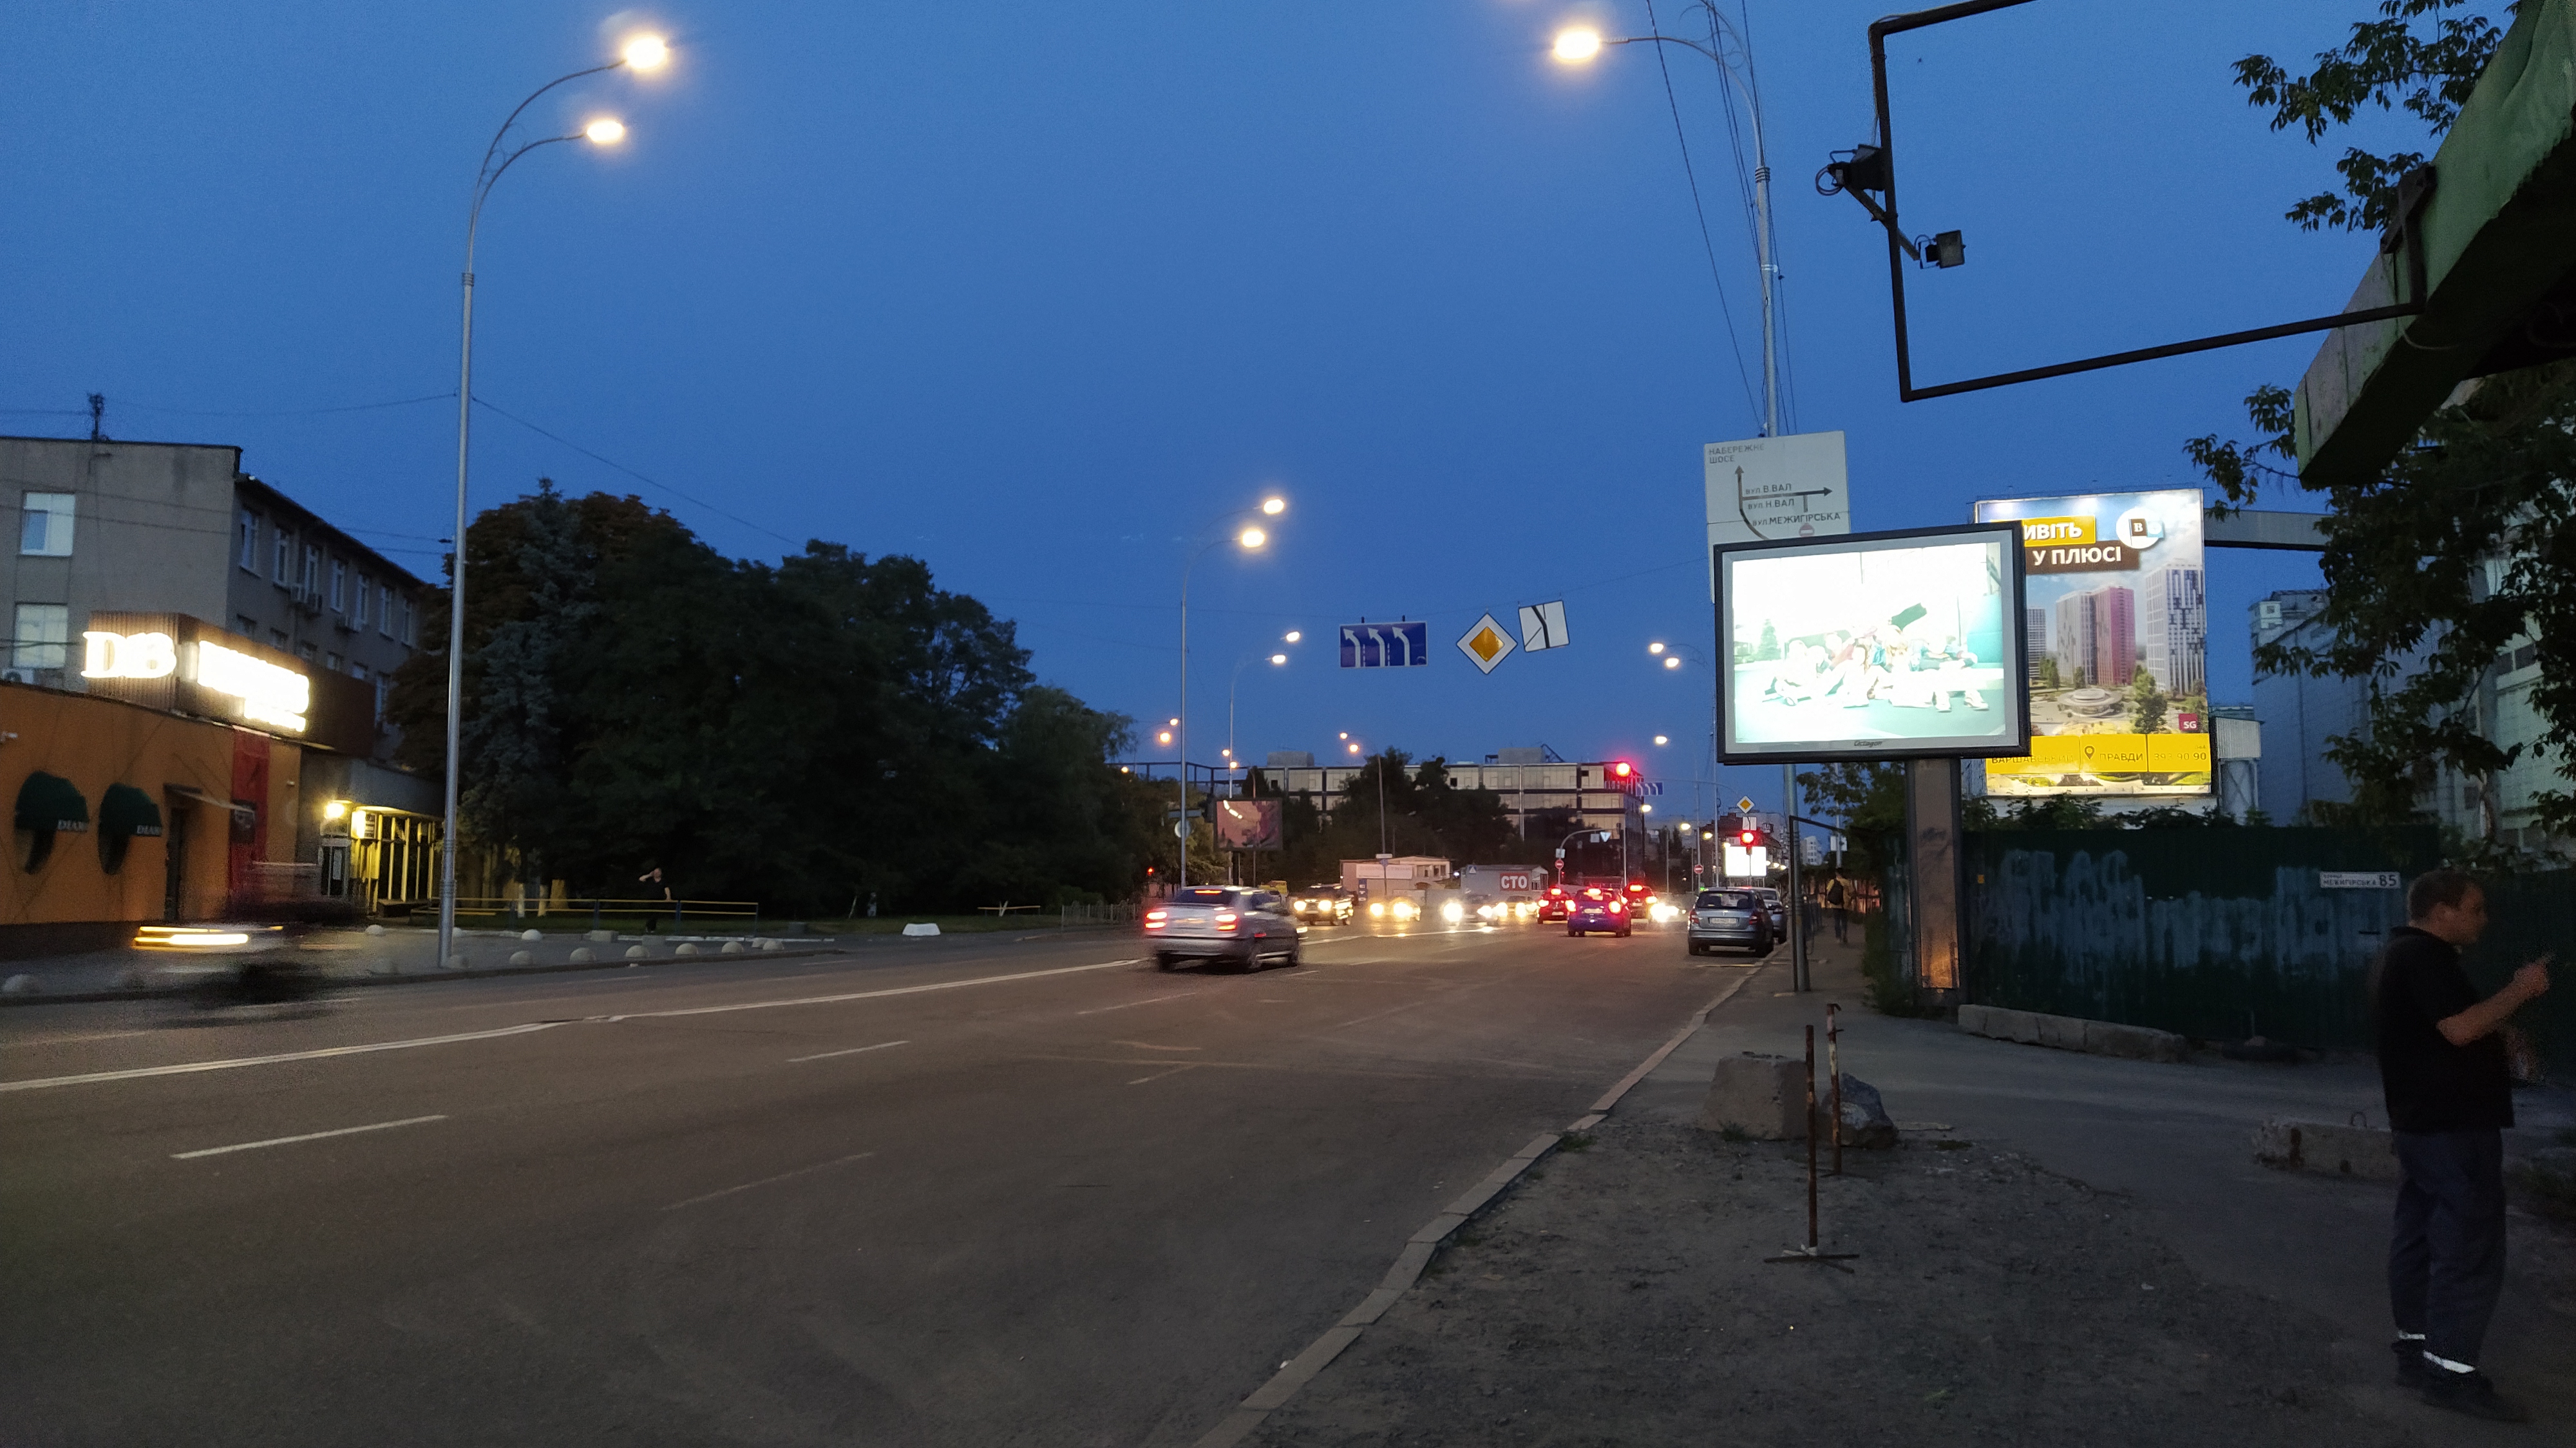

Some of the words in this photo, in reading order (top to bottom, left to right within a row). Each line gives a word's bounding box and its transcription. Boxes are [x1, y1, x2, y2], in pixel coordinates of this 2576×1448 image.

[1709, 455, 1735, 464] ШОСЕ
[1770, 513, 1841, 524] МЕЖИГІРСЬКА
[2023, 522, 2083, 540] ИВІТЬ
[2032, 549, 2047, 566] У
[2051, 546, 2121, 565] ПЛЮСІ
[2099, 753, 2143, 763] ПРАВДИ
[1501, 875, 1527, 889] СТО
